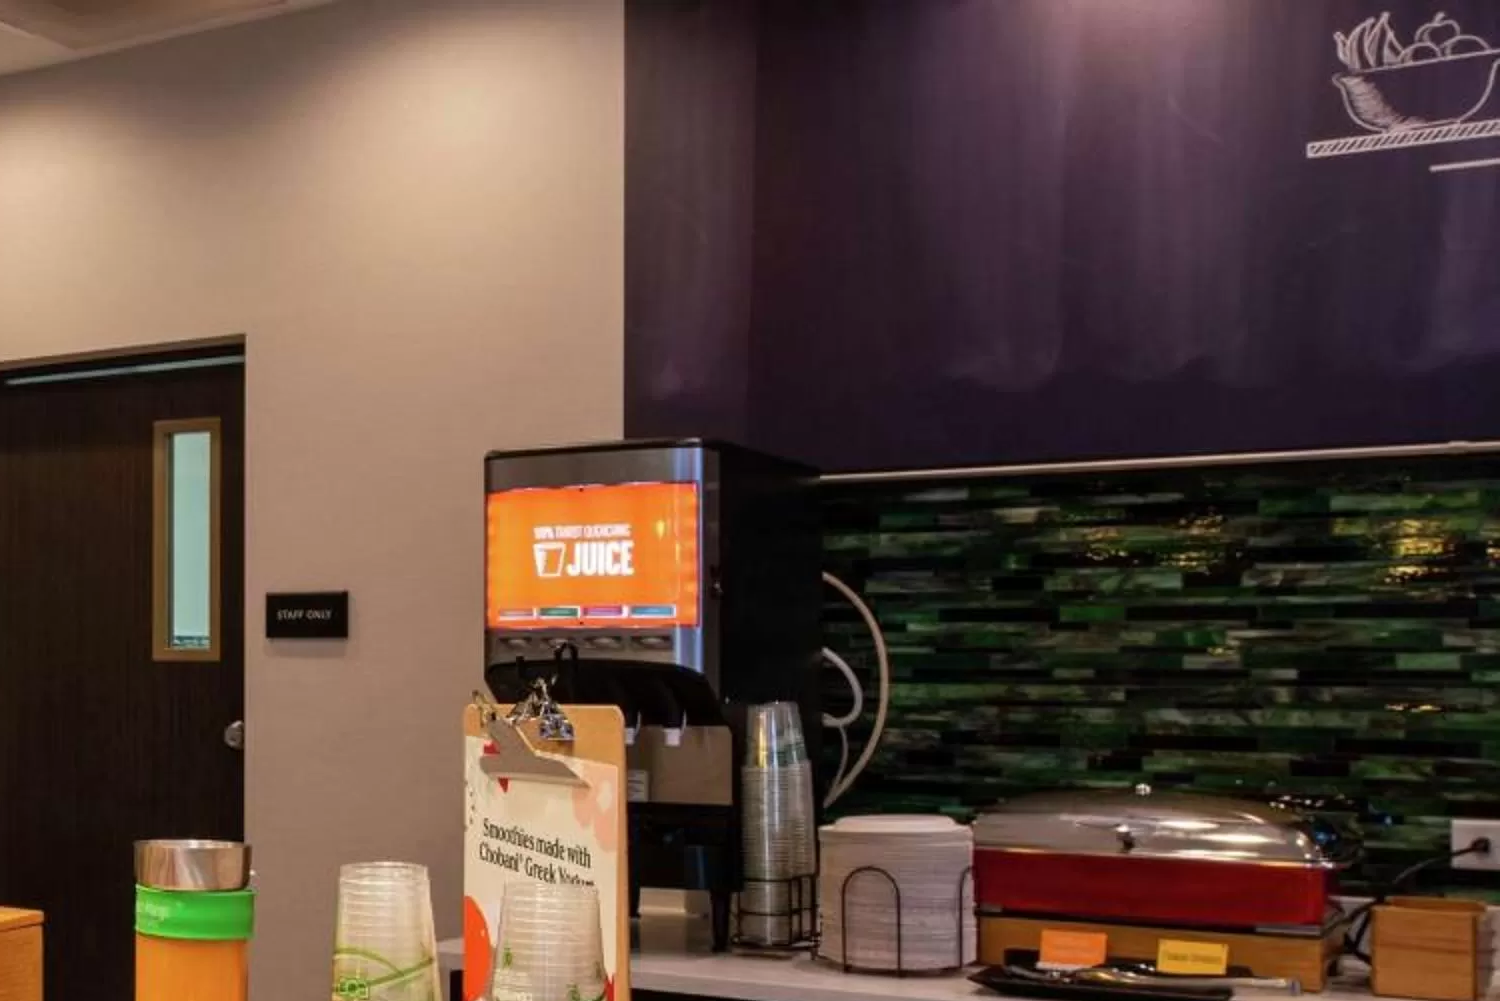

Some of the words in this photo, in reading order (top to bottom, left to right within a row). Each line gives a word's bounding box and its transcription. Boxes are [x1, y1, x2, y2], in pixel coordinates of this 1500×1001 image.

[566, 541, 634, 577] JUICE
[277, 608, 304, 620] STAFF
[306, 608, 333, 620] ONLY
[483, 818, 534, 851] Smoothies
[536, 838, 565, 861] made
[567, 845, 592, 869] with
[524, 856, 556, 884] Greek
